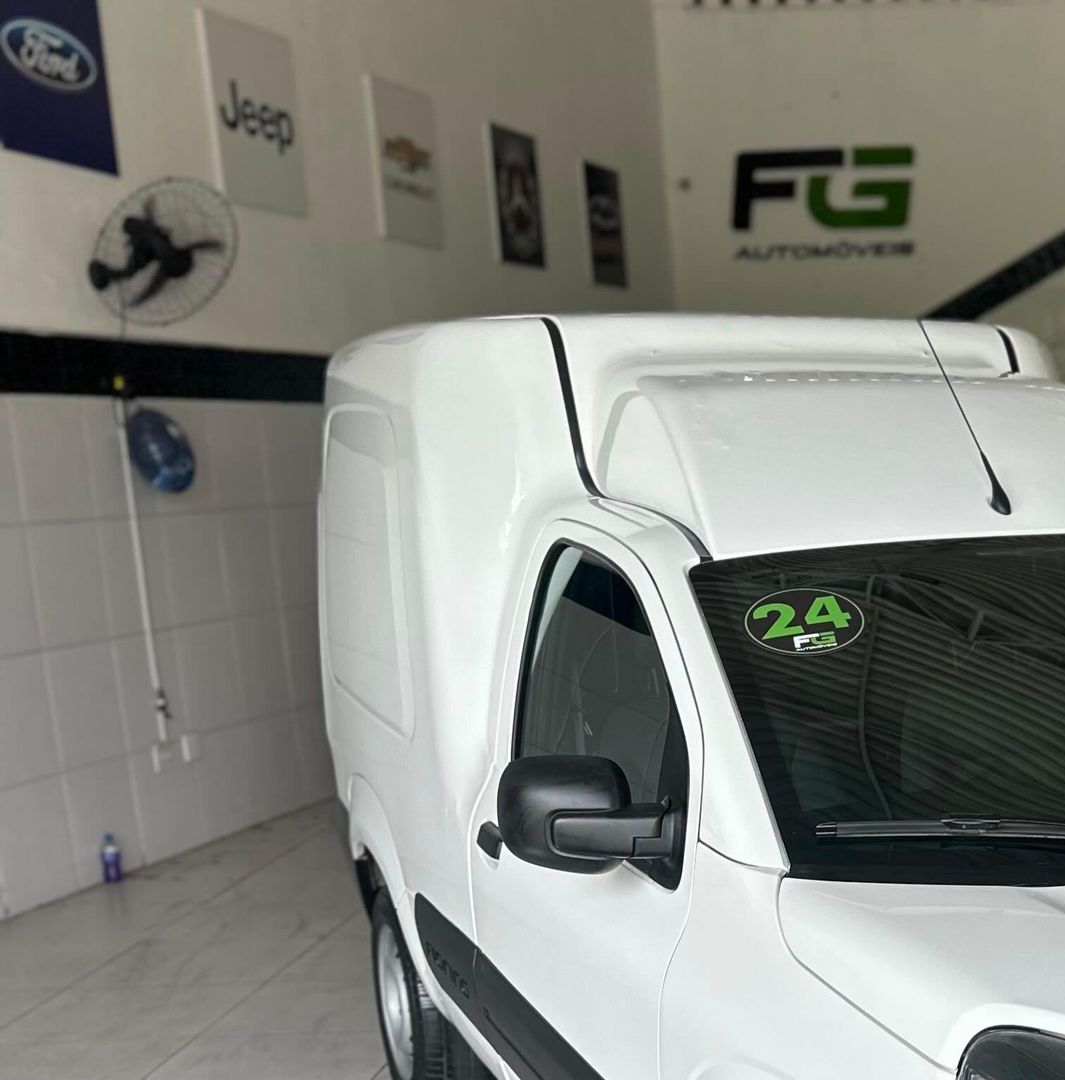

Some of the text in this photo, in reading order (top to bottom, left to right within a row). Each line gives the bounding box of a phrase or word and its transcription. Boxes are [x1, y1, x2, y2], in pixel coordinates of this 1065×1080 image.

[20, 27, 81, 81] Ford
[218, 80, 294, 156] Jeep
[732, 146, 914, 230] FG
[752, 595, 852, 640] 24
[793, 631, 836, 649] FG
